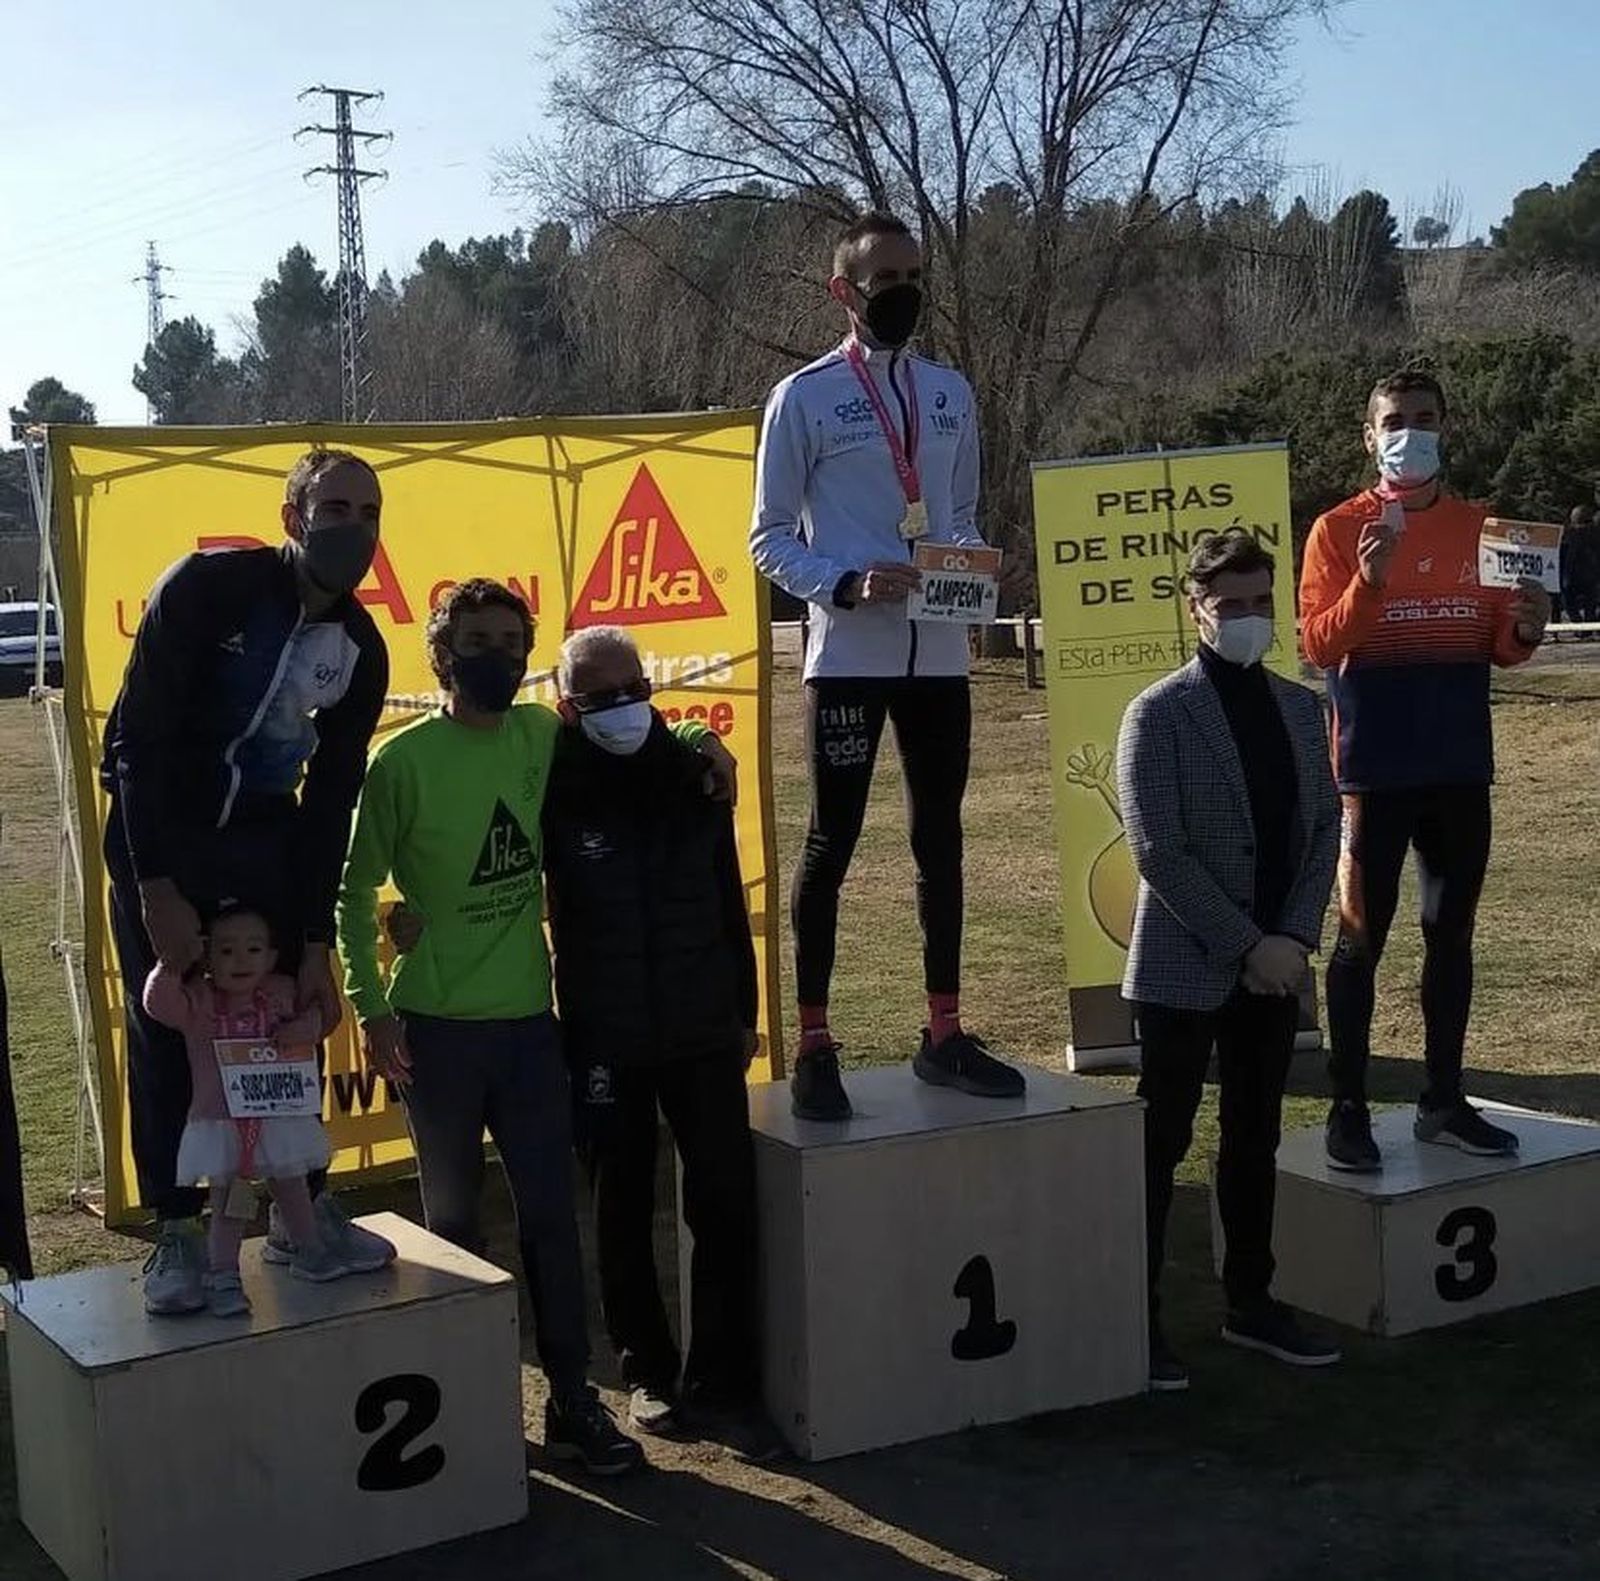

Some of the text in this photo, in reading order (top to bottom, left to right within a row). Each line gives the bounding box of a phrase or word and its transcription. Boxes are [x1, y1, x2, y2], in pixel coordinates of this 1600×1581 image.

[1097, 483, 1234, 517] PERAS
[590, 517, 703, 613] Sika
[943, 554, 969, 570] GO
[1054, 537, 1108, 565] DE
[1497, 551, 1543, 576] TERCERO
[926, 575, 984, 608] CAMPEÓN
[1081, 579, 1134, 605] DE
[1111, 642, 1166, 665] PERA
[250, 1047, 277, 1062] GO
[1434, 1207, 1500, 1301] 3
[951, 1255, 1017, 1360] 1
[355, 1373, 446, 1492] 2
